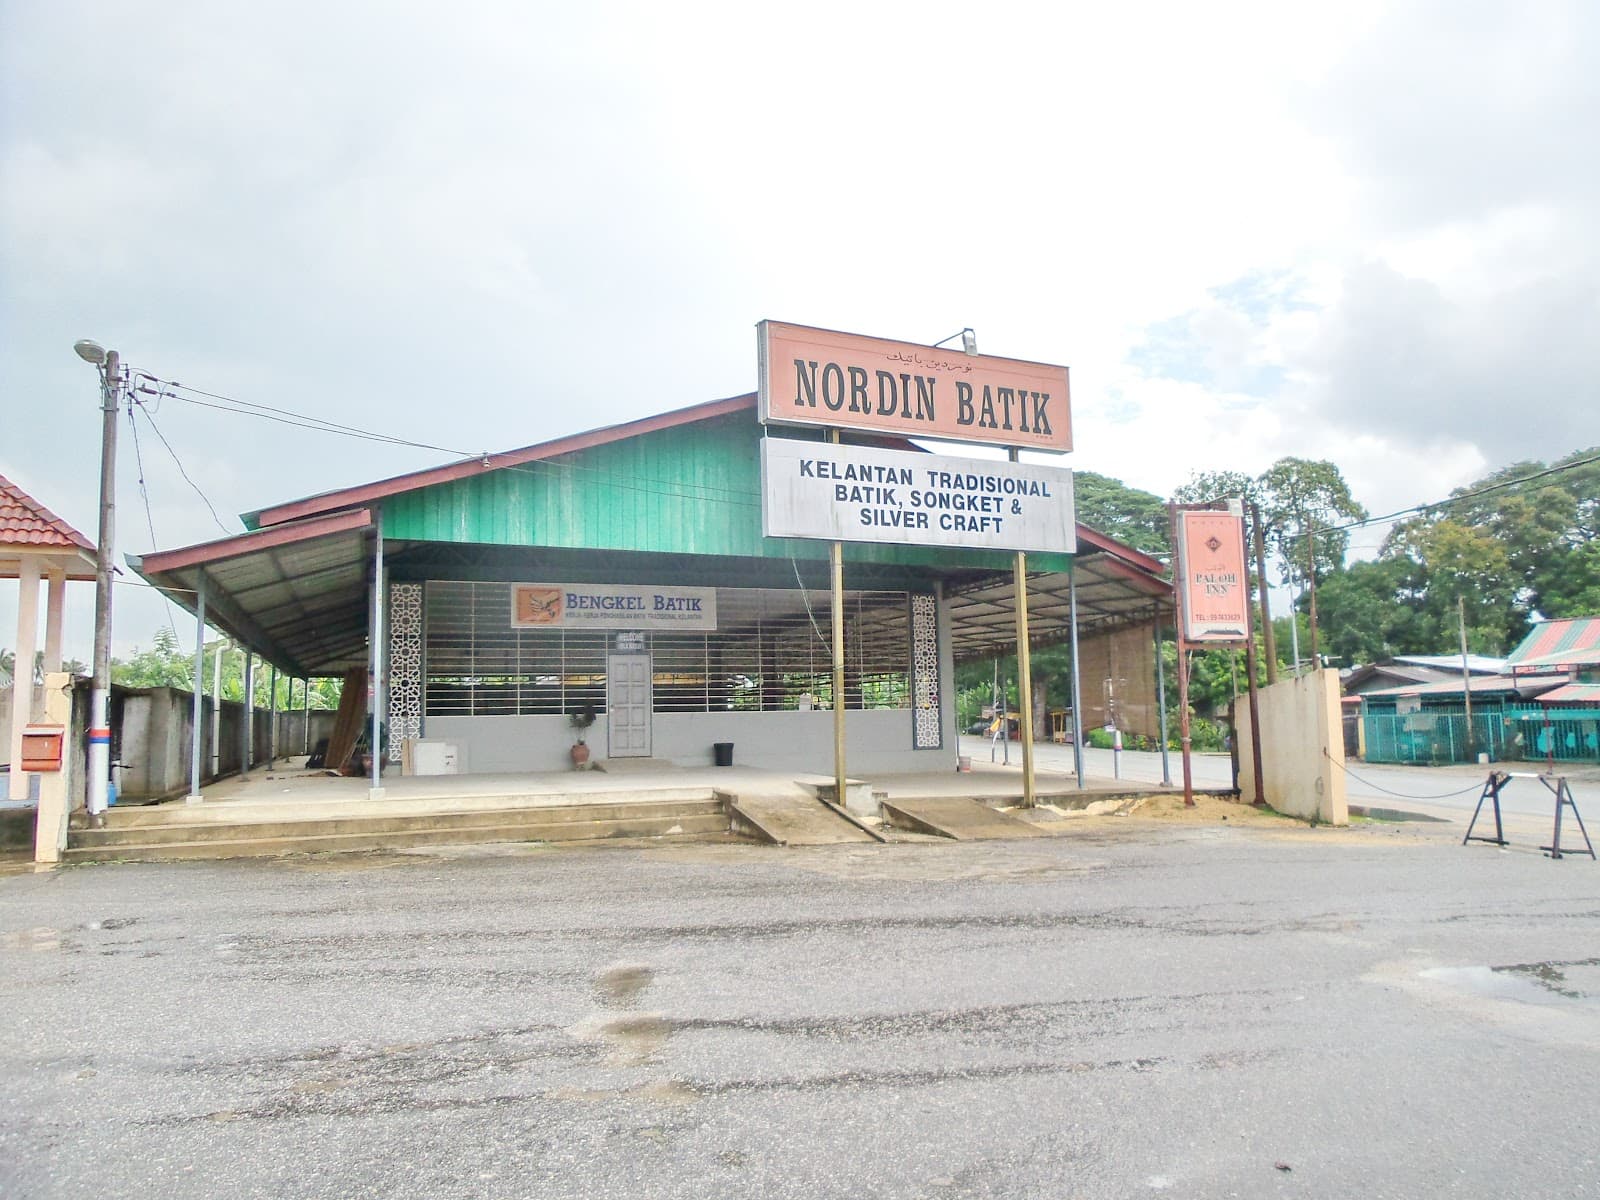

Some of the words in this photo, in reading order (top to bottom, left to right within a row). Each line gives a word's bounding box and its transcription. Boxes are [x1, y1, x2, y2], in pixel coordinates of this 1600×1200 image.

[793, 359, 936, 422] NORDIN
[955, 381, 1053, 435] BATIK
[799, 459, 913, 486] KELANTAN
[927, 471, 1051, 498] TRADISIONAL
[835, 484, 904, 509] BATIK,
[910, 490, 1003, 514] SONGKET
[1011, 499, 1022, 515] &
[860, 508, 929, 529] SILVER
[939, 513, 1003, 534] CRAFT
[1195, 573, 1237, 584] PALOH
[1205, 584, 1228, 595] INN
[566, 593, 646, 610] BENGKEL
[653, 595, 702, 611] BATIK
